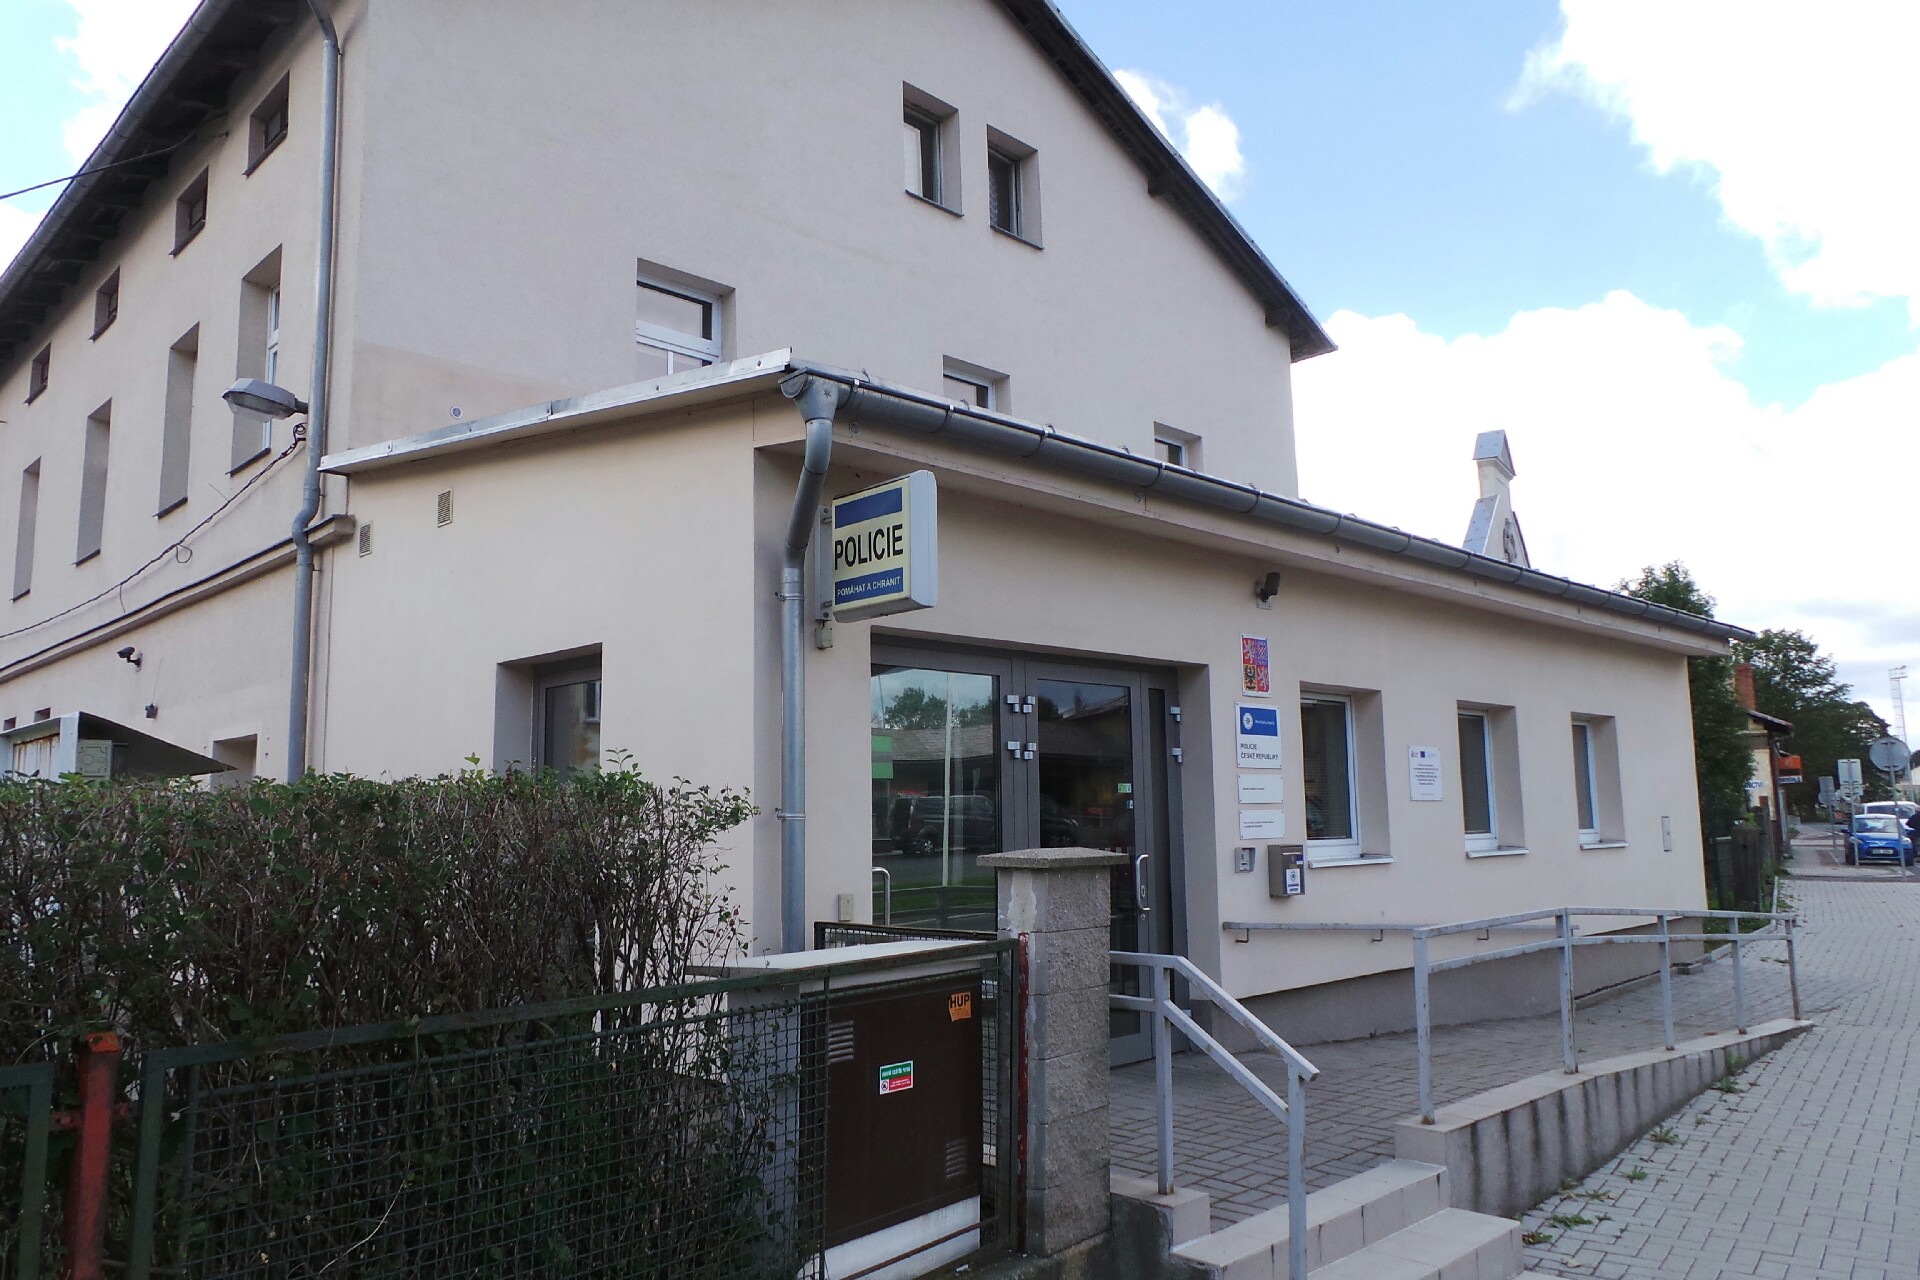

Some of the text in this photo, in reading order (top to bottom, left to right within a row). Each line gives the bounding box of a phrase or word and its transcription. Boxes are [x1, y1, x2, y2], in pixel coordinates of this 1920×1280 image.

[835, 524, 903, 570] POLICIE
[837, 583, 866, 597] POMÁHAT
[873, 576, 900, 589] CHRÁNIT
[1255, 752, 1279, 760] REPUBLIKY
[950, 994, 970, 1008] HUP
